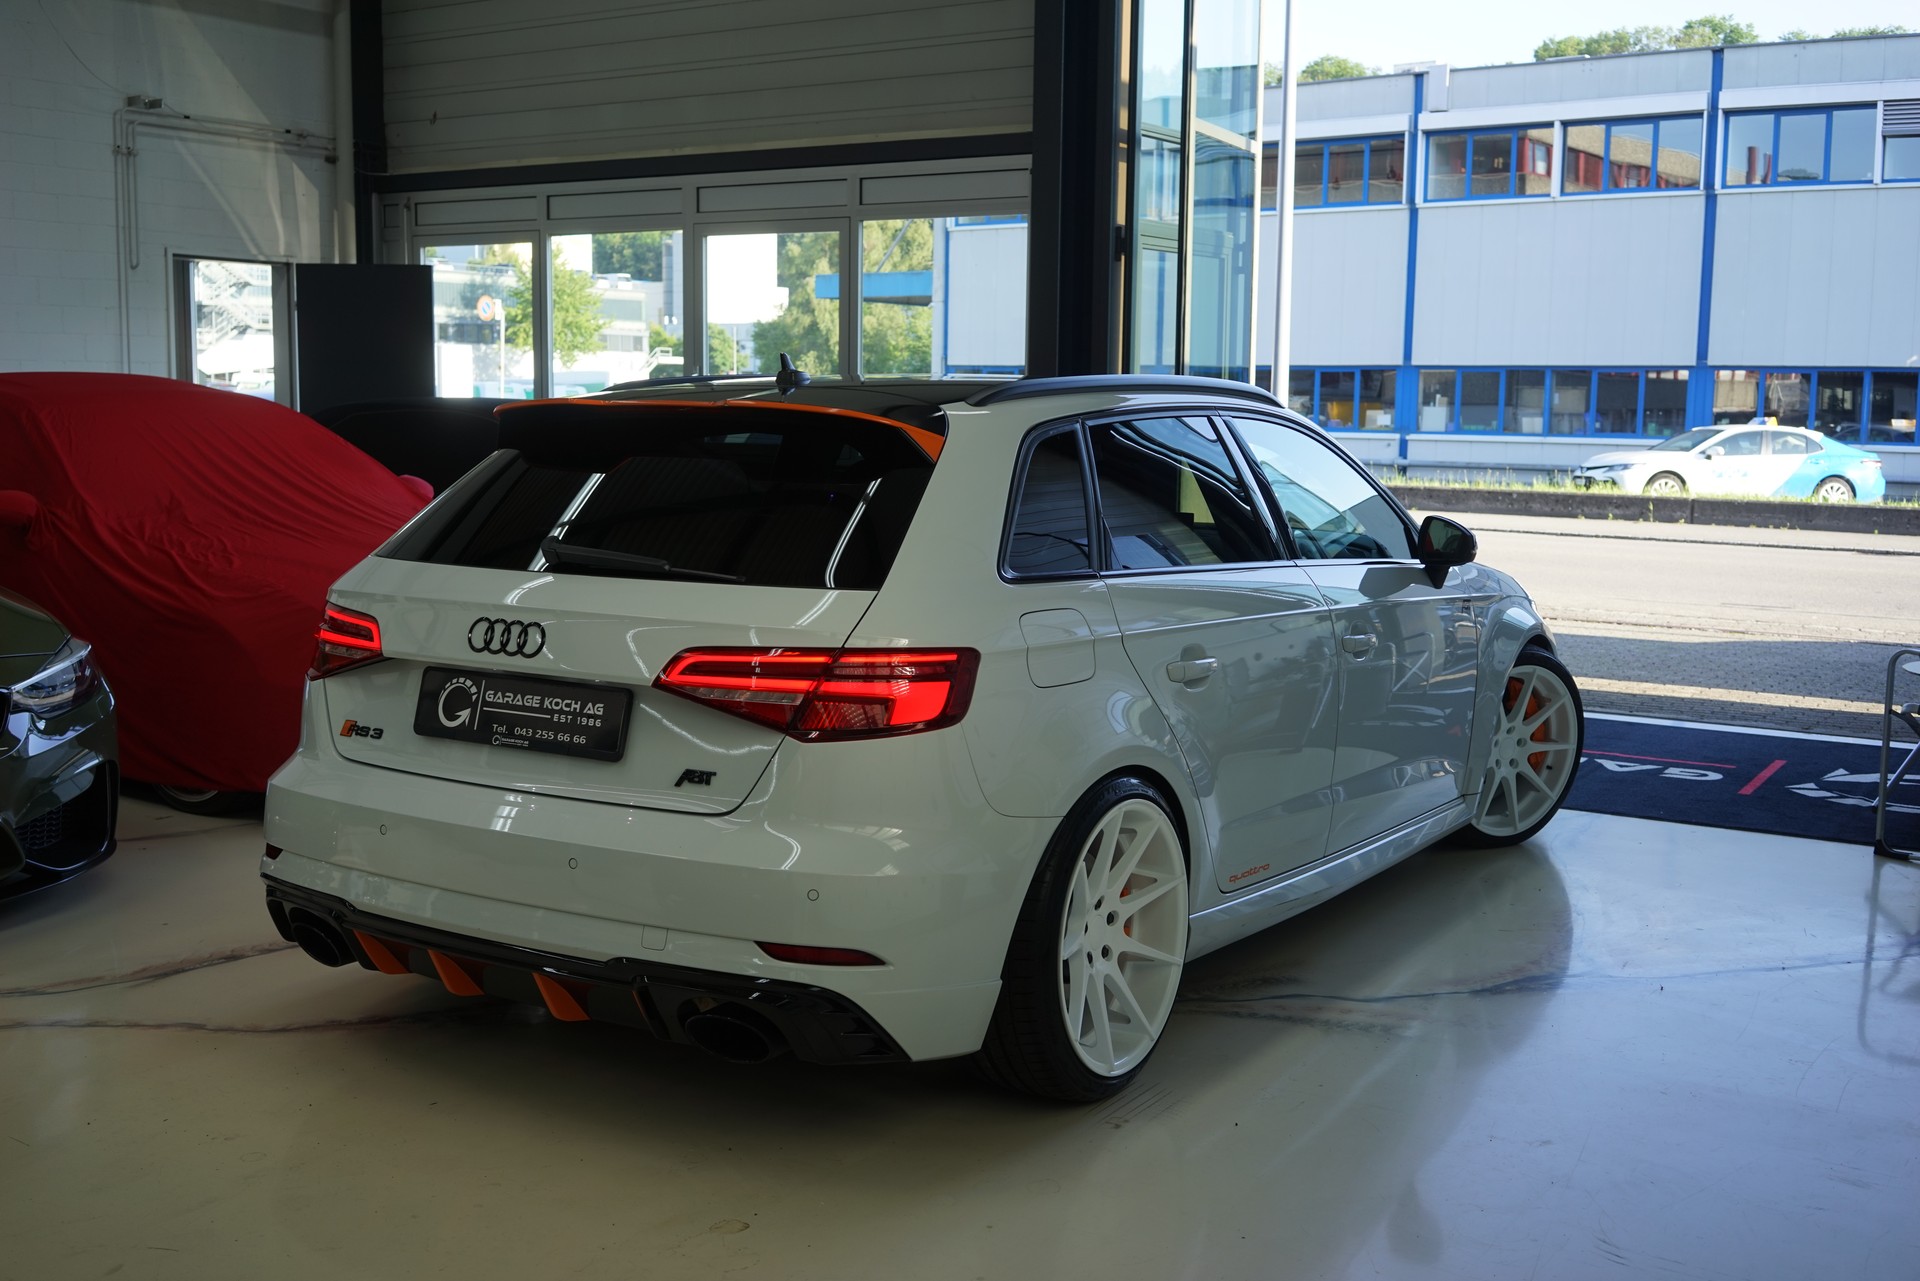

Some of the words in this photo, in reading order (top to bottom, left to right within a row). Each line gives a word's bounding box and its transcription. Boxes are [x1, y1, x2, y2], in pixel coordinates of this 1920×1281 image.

[485, 690, 542, 708] GARAGE
[543, 697, 581, 713] KOCH
[583, 702, 605, 716] AG
[553, 713, 573, 723] EST
[577, 716, 602, 727] 1986
[492, 723, 508, 734] Tel.
[514, 726, 533, 737] 043
[535, 729, 555, 740] 255
[557, 732, 571, 742] 66
[573, 734, 587, 744] 66
[674, 768, 717, 788] ABT
[1228, 863, 1270, 884] quattro
